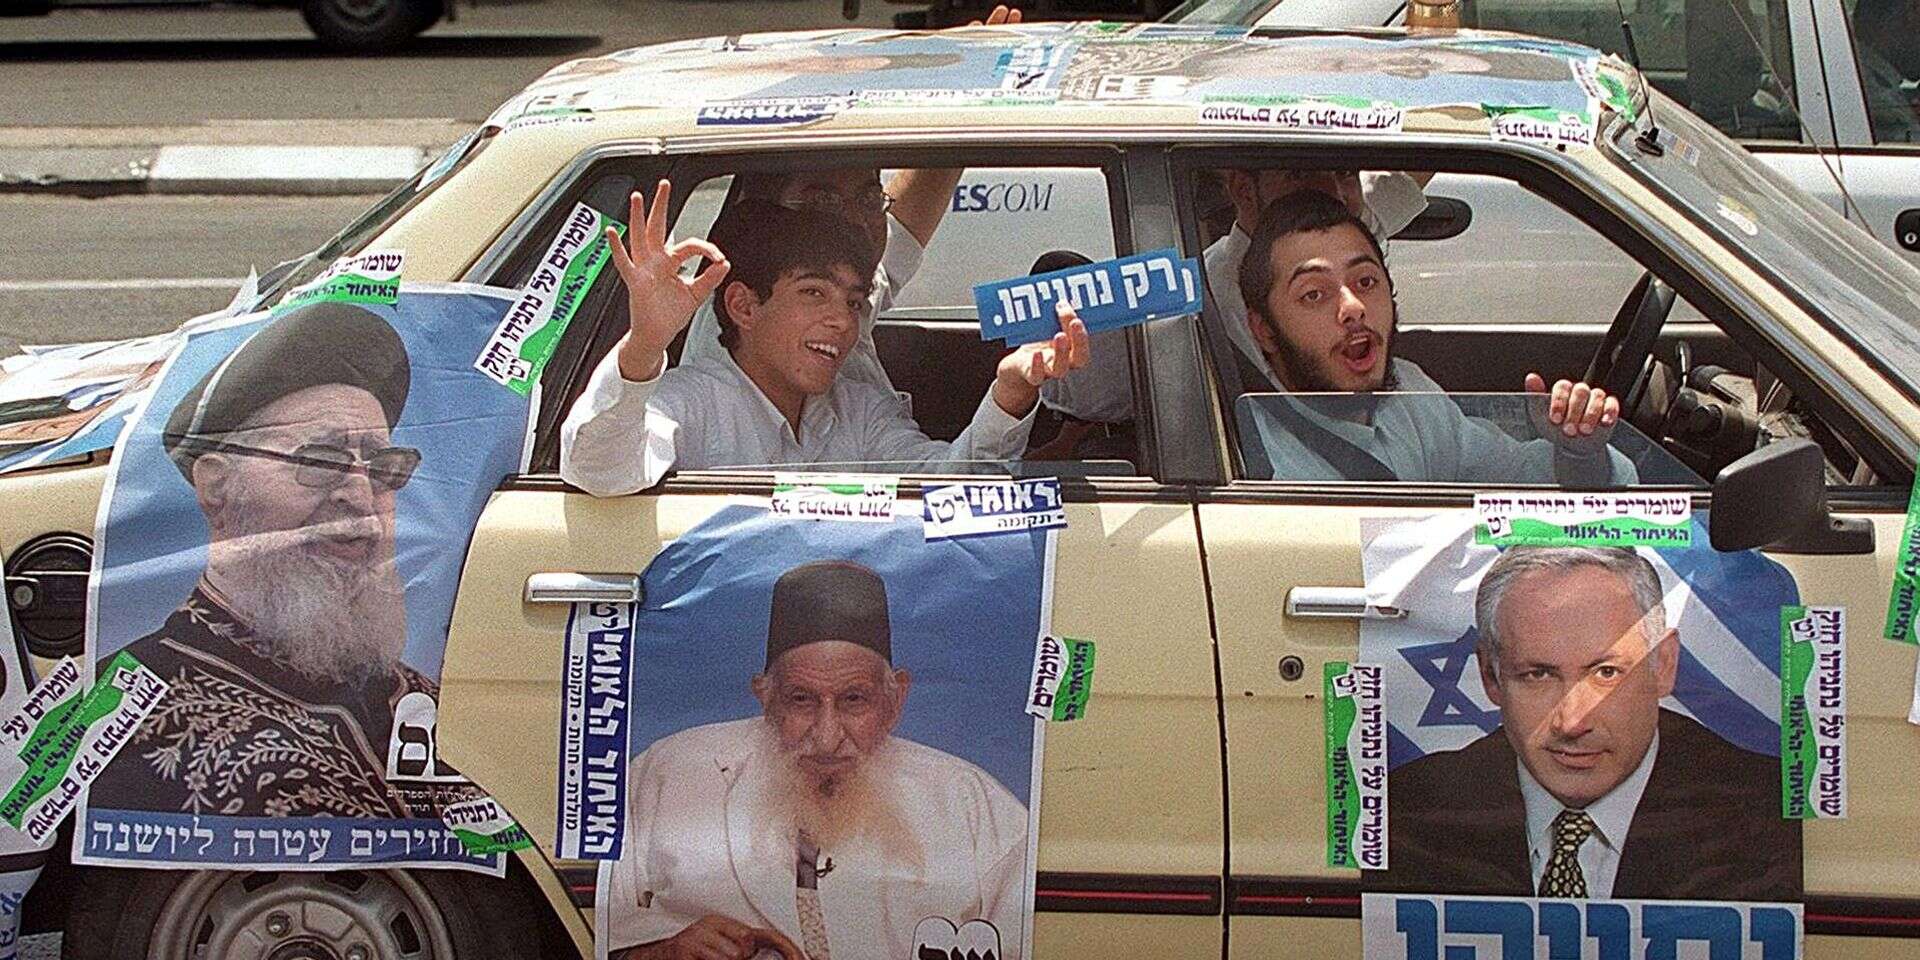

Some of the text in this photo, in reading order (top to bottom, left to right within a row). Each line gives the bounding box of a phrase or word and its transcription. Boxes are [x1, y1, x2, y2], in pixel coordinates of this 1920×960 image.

[952, 183, 1053, 213] ESCOM
[548, 206, 595, 270] שומרים
[531, 269, 556, 293] על
[1121, 257, 1177, 310] רק
[501, 294, 543, 343] נתניהו
[480, 341, 512, 379] חזק
[1615, 499, 1687, 515] שומרים
[1, 661, 80, 741] שומרים על
[1033, 636, 1060, 707] שומרים
[566, 655, 584, 830] מולדת חרות תקומה
[584, 632, 626, 854] האיחוד הלאומי
[1812, 610, 1844, 817] שומרים על נתניהו חזק
[26, 776, 81, 841] שומרים
[75, 754, 100, 781] על
[92, 708, 141, 757] נתניהו
[1354, 665, 1386, 868] שומרים על נתניהו חזק
[92, 815, 488, 863] חזירים עטרה ליושנה
